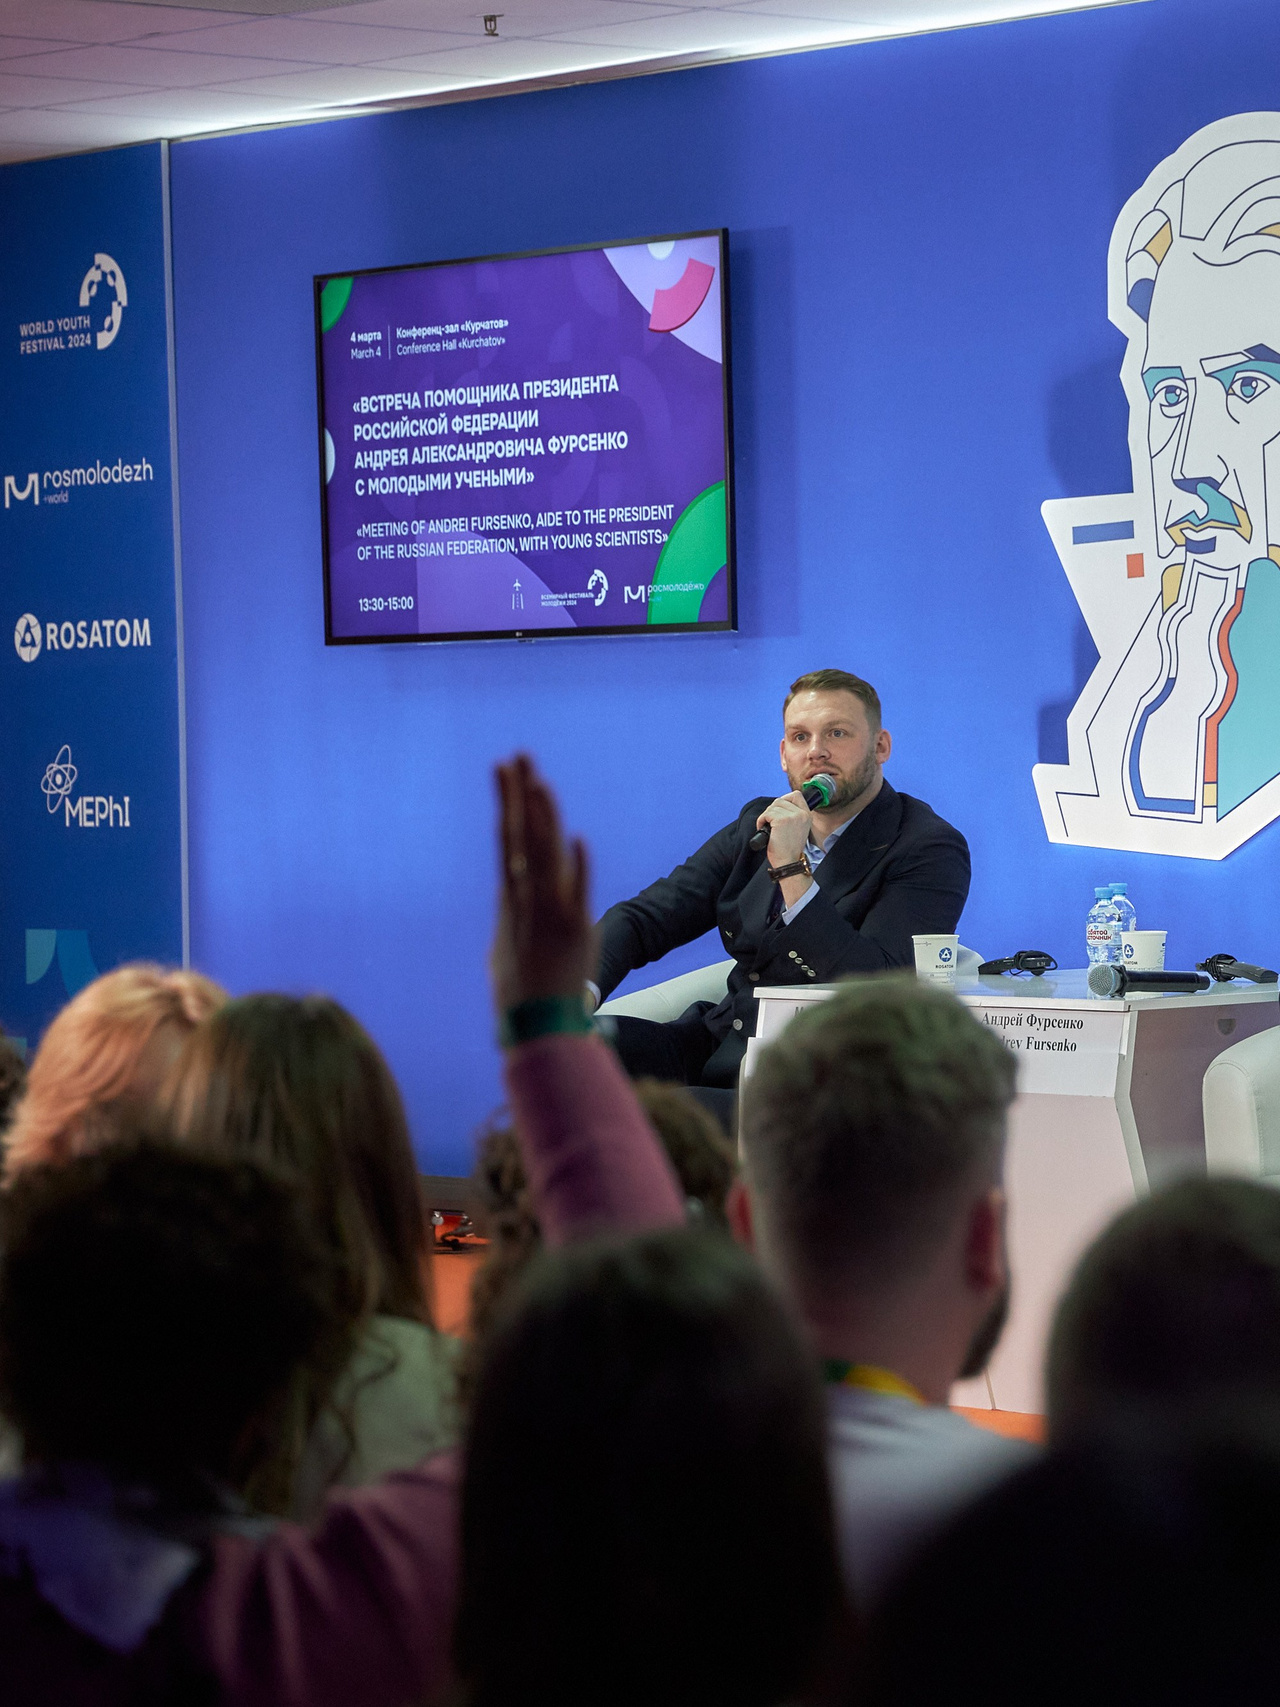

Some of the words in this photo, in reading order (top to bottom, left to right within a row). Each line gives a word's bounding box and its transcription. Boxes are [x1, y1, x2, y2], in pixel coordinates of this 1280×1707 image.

[20, 320, 54, 337] WORLD
[57, 315, 90, 332] YOUTH
[350, 332, 356, 343] 4
[357, 331, 382, 343] марта
[396, 323, 459, 339] Конференц-зал
[461, 319, 508, 335] «Курчатов»
[20, 336, 65, 354] FESTIVAL
[67, 333, 91, 348] 2024
[351, 349, 374, 360] March
[376, 347, 381, 357] 4
[397, 341, 441, 356] Conference
[442, 339, 456, 350] Hall
[458, 335, 505, 349] «Kurchatov»
[353, 392, 421, 413] «ВСТРЕЧА
[425, 383, 520, 408] ПОМОЩНИКА
[523, 374, 619, 399] ПРЕЗИДЕНТА
[354, 413, 448, 441] РОССИЙСКОЙ
[452, 410, 538, 436] ФЕДЕРАЦИИ
[355, 449, 408, 471] АНДРЕЯ
[412, 438, 545, 464] АЛЕКСАНДРОВИЧА
[548, 431, 628, 454] ФУРСЕНКО
[44, 457, 153, 488] rosmolodezh
[355, 479, 364, 496] С
[369, 472, 450, 496] МОЛОДЫМИ
[455, 467, 534, 489] УЧЕНЫМИ»
[357, 522, 408, 538] «MEETING
[411, 520, 425, 535] OF
[428, 517, 469, 533] ANDREI
[471, 513, 534, 531] FURSENKO,
[536, 512, 562, 527] AIDE
[565, 510, 580, 525] TO
[583, 509, 606, 524] THE
[609, 504, 674, 523] PRESIDENT
[358, 546, 372, 560] OF
[374, 545, 394, 559] THE
[397, 542, 444, 558] RUSSIAN
[447, 538, 518, 556] FEDERATION,
[519, 536, 548, 551] WITH
[551, 534, 592, 549] YOUNG
[595, 529, 668, 548] SCIENTISTS»
[647, 581, 704, 596] росмолодёжь
[359, 596, 414, 612] 13:30-15:00
[46, 618, 151, 650] ROSATOM
[65, 796, 130, 827] MEPhI
[982, 1012, 1023, 1029] Андрей
[1026, 1014, 1084, 1031] Фурсенко
[1026, 1036, 1077, 1052] Fursenko
